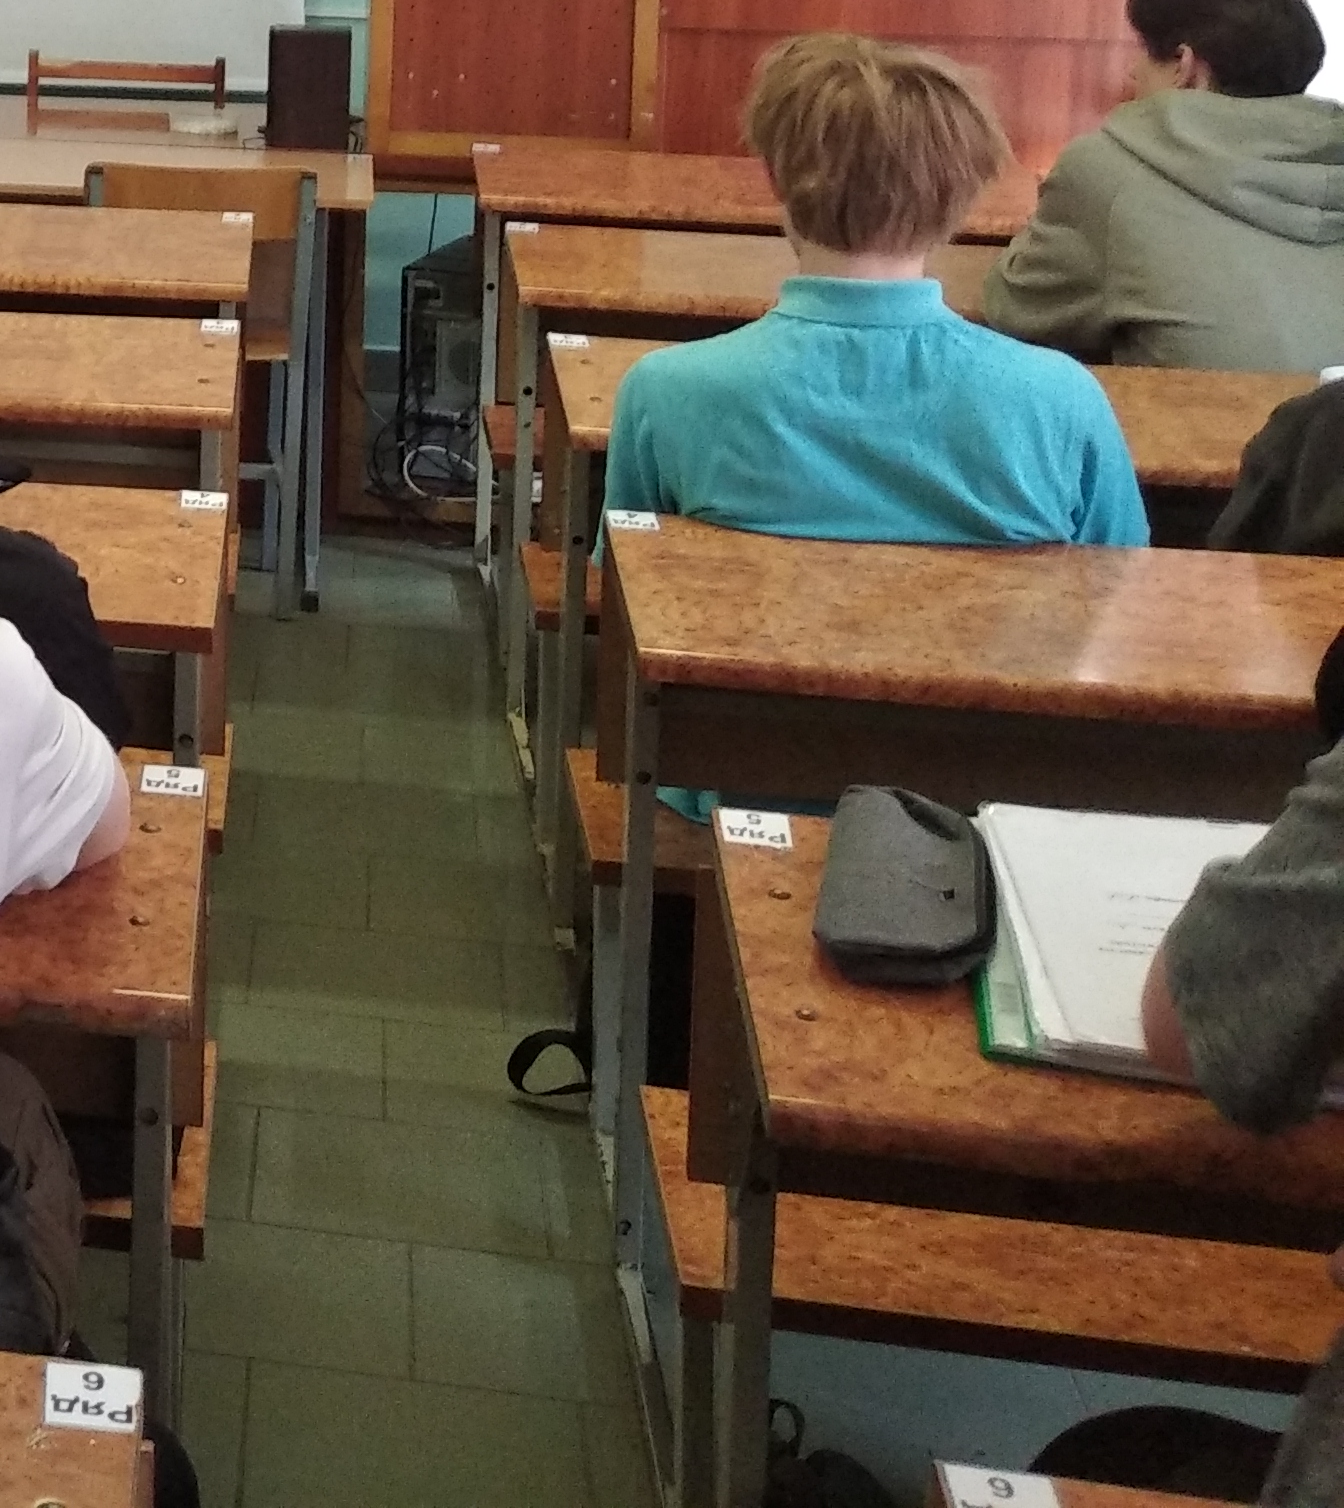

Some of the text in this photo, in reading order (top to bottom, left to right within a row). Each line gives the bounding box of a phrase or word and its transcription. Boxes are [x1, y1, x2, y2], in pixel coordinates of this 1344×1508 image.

[145, 778, 199, 793] Ряд
[746, 813, 762, 825] 5
[727, 825, 787, 844] Ряд
[81, 1371, 106, 1391] 6
[50, 1394, 134, 1424] Ряд
[987, 1476, 1015, 1499] 6
